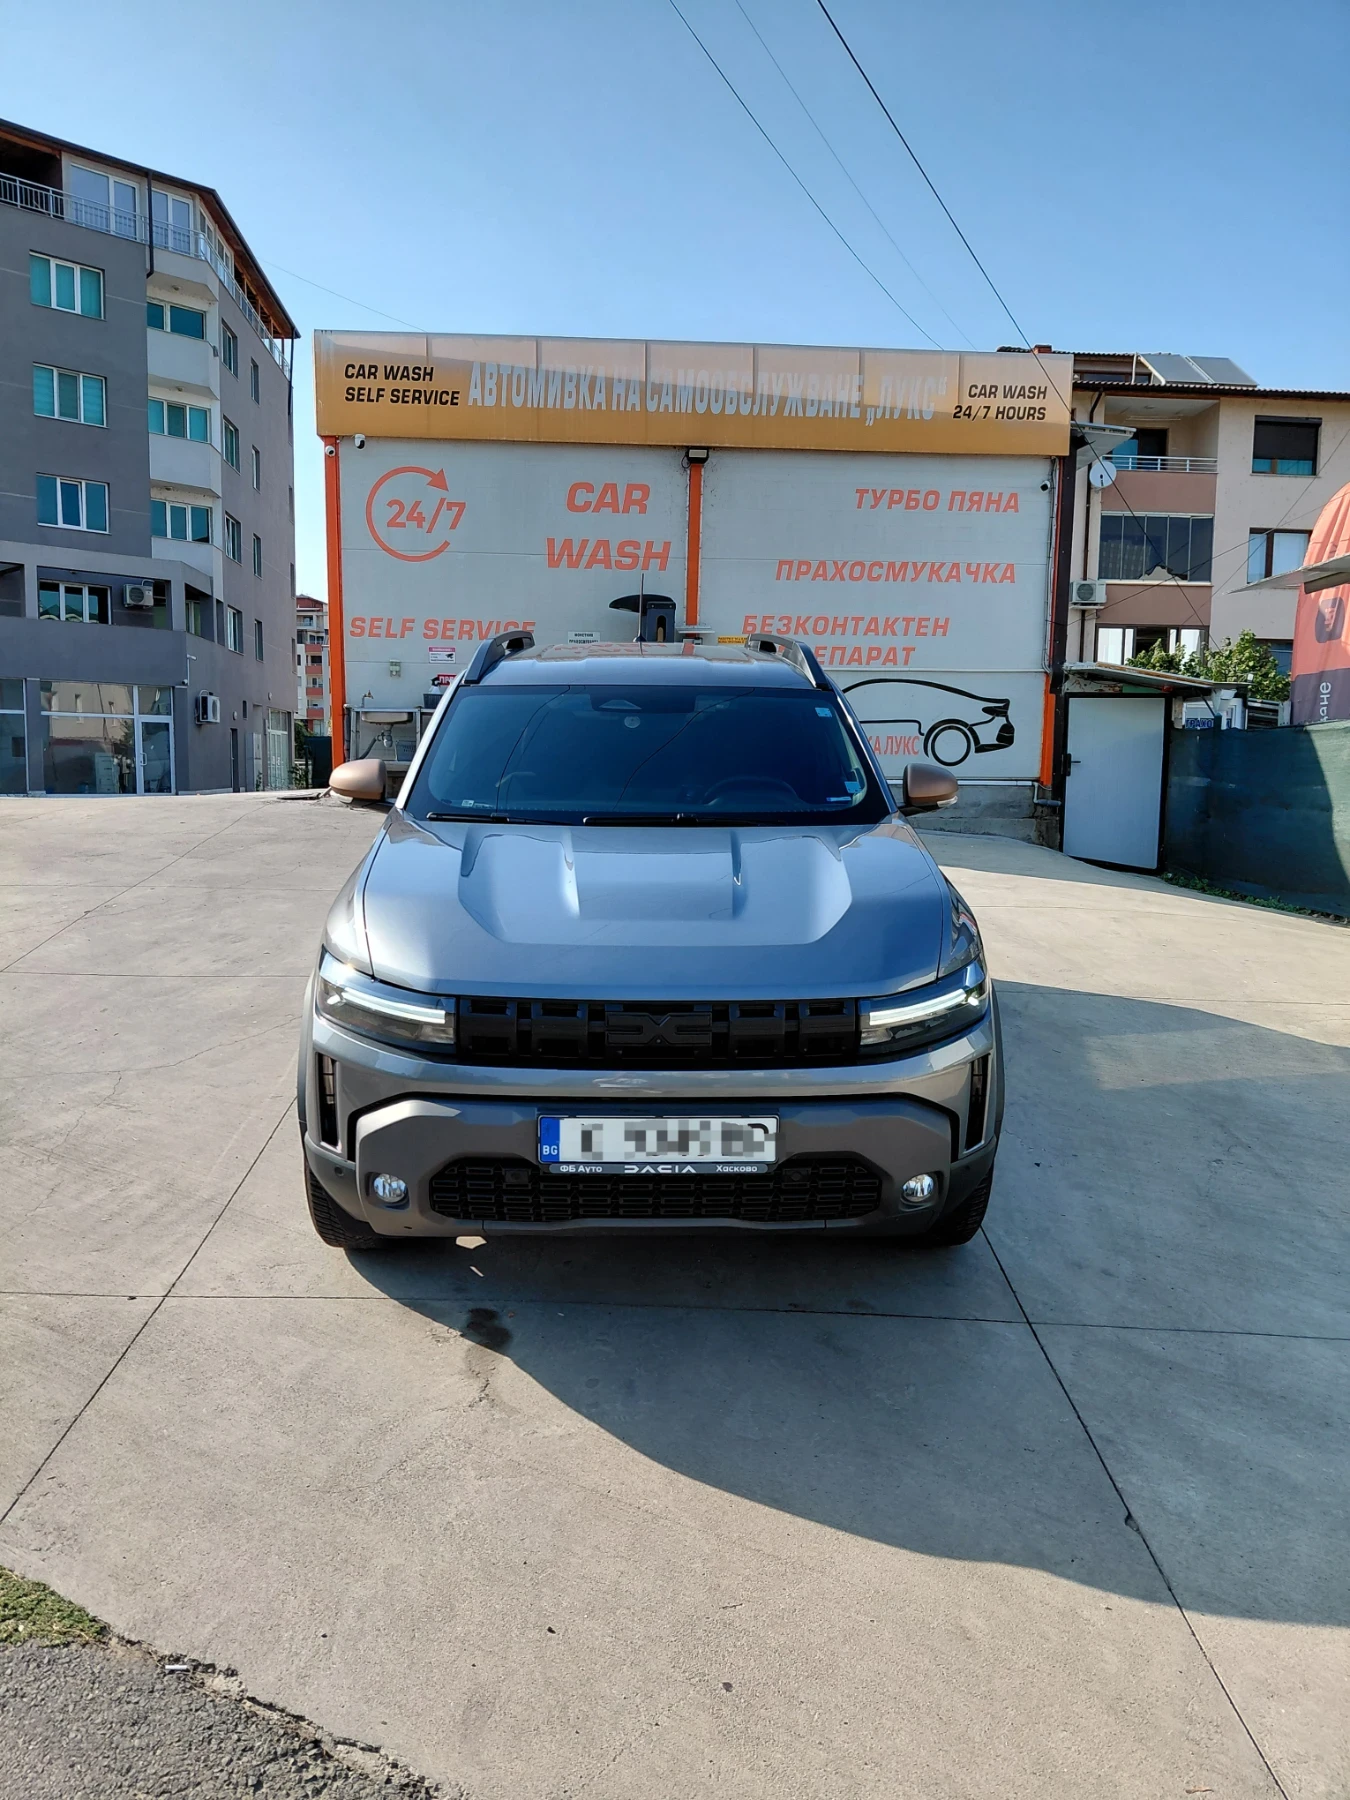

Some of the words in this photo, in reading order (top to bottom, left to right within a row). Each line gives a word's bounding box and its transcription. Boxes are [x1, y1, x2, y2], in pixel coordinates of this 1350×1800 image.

[344, 364, 379, 380] CAR
[384, 365, 434, 381] WASH
[344, 386, 385, 403] SELF
[390, 388, 460, 406] SERVICE
[467, 362, 606, 410] АВТОМИВКА
[612, 367, 641, 412] НА
[646, 368, 863, 418] САМООБСЛУЖВАНЕ
[967, 384, 998, 399] CAR
[1002, 385, 1048, 400] WASH
[952, 405, 991, 421] 24/7
[995, 406, 1047, 421] HOURS
[566, 481, 650, 514] CAR
[855, 488, 941, 511] ТУРБО
[948, 490, 1020, 513] ПЯНА
[386, 497, 467, 534] 24/7
[546, 537, 672, 572] WASH
[775, 559, 1016, 584] ПРАХОСМУКАЧКА
[350, 616, 416, 639] SELF
[741, 615, 950, 637] БЕЗКОНТАКТЕН
[778, 644, 916, 666] ЕПАРАТ
[884, 735, 920, 756] ЛУКС
[543, 1145, 558, 1155] BG
[624, 1165, 697, 1174] DACIA
[715, 1164, 758, 1173] Хасково
